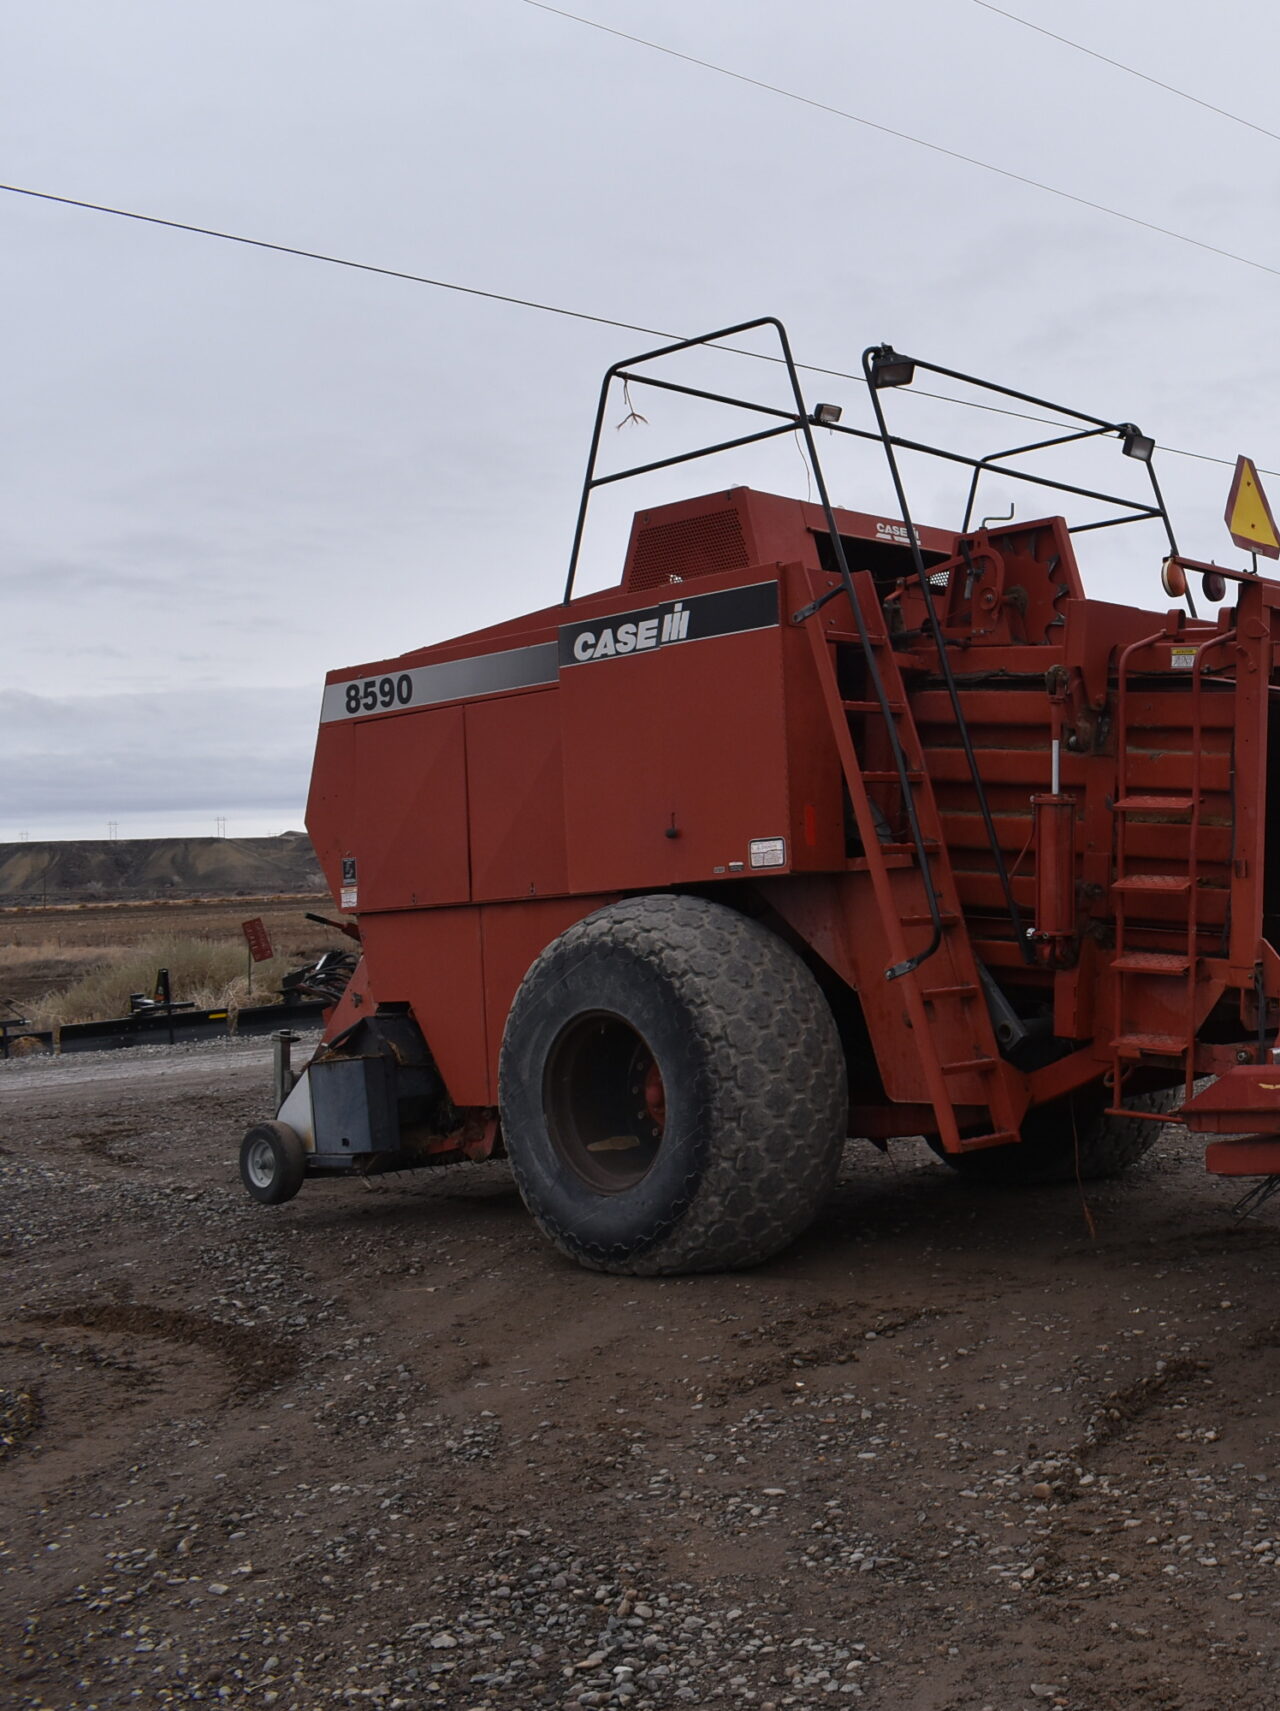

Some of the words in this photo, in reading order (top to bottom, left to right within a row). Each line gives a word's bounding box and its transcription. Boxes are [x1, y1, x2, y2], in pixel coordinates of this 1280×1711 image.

[876, 522, 907, 537] CASE
[573, 618, 659, 662] CASE
[346, 673, 413, 714] 8590
